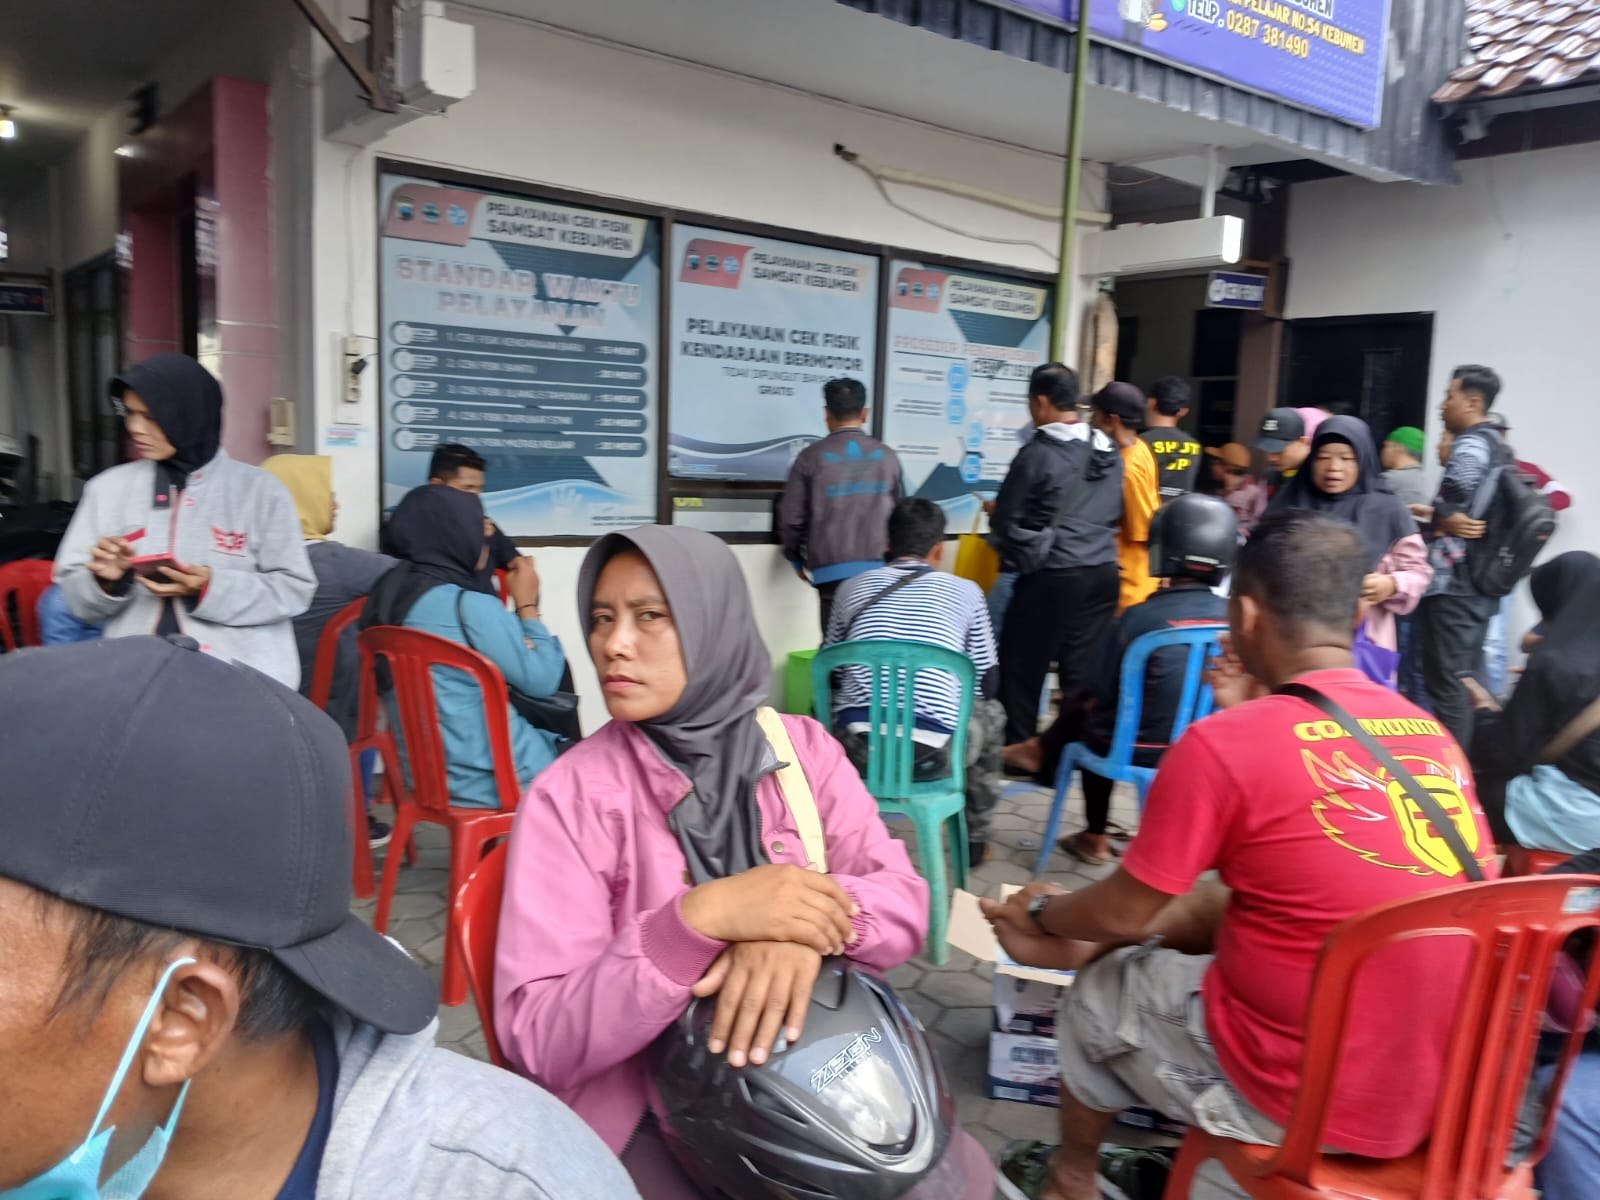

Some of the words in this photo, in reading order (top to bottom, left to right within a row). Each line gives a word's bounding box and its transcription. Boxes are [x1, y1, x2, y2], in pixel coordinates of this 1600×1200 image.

[1226, 9, 1260, 38] 0287
[1263, 24, 1309, 58] 381490
[1291, 10, 1320, 36] NO.54
[1321, 23, 1365, 55] KEBUMEN
[487, 201, 571, 225] PELAYANAN
[487, 219, 555, 242] SAMSAT
[559, 229, 633, 251] KEBUMEN
[396, 255, 537, 297] STANDAR
[752, 267, 801, 284] SAMSAT
[804, 275, 859, 292] KEBUMEN
[437, 291, 606, 327] PELAYANAN
[686, 317, 786, 342] PELAYANAN
[789, 329, 819, 346] CEK
[822, 333, 861, 350] FISIK
[680, 340, 780, 365] KENDARAAN
[784, 351, 864, 371] BERMOTOR
